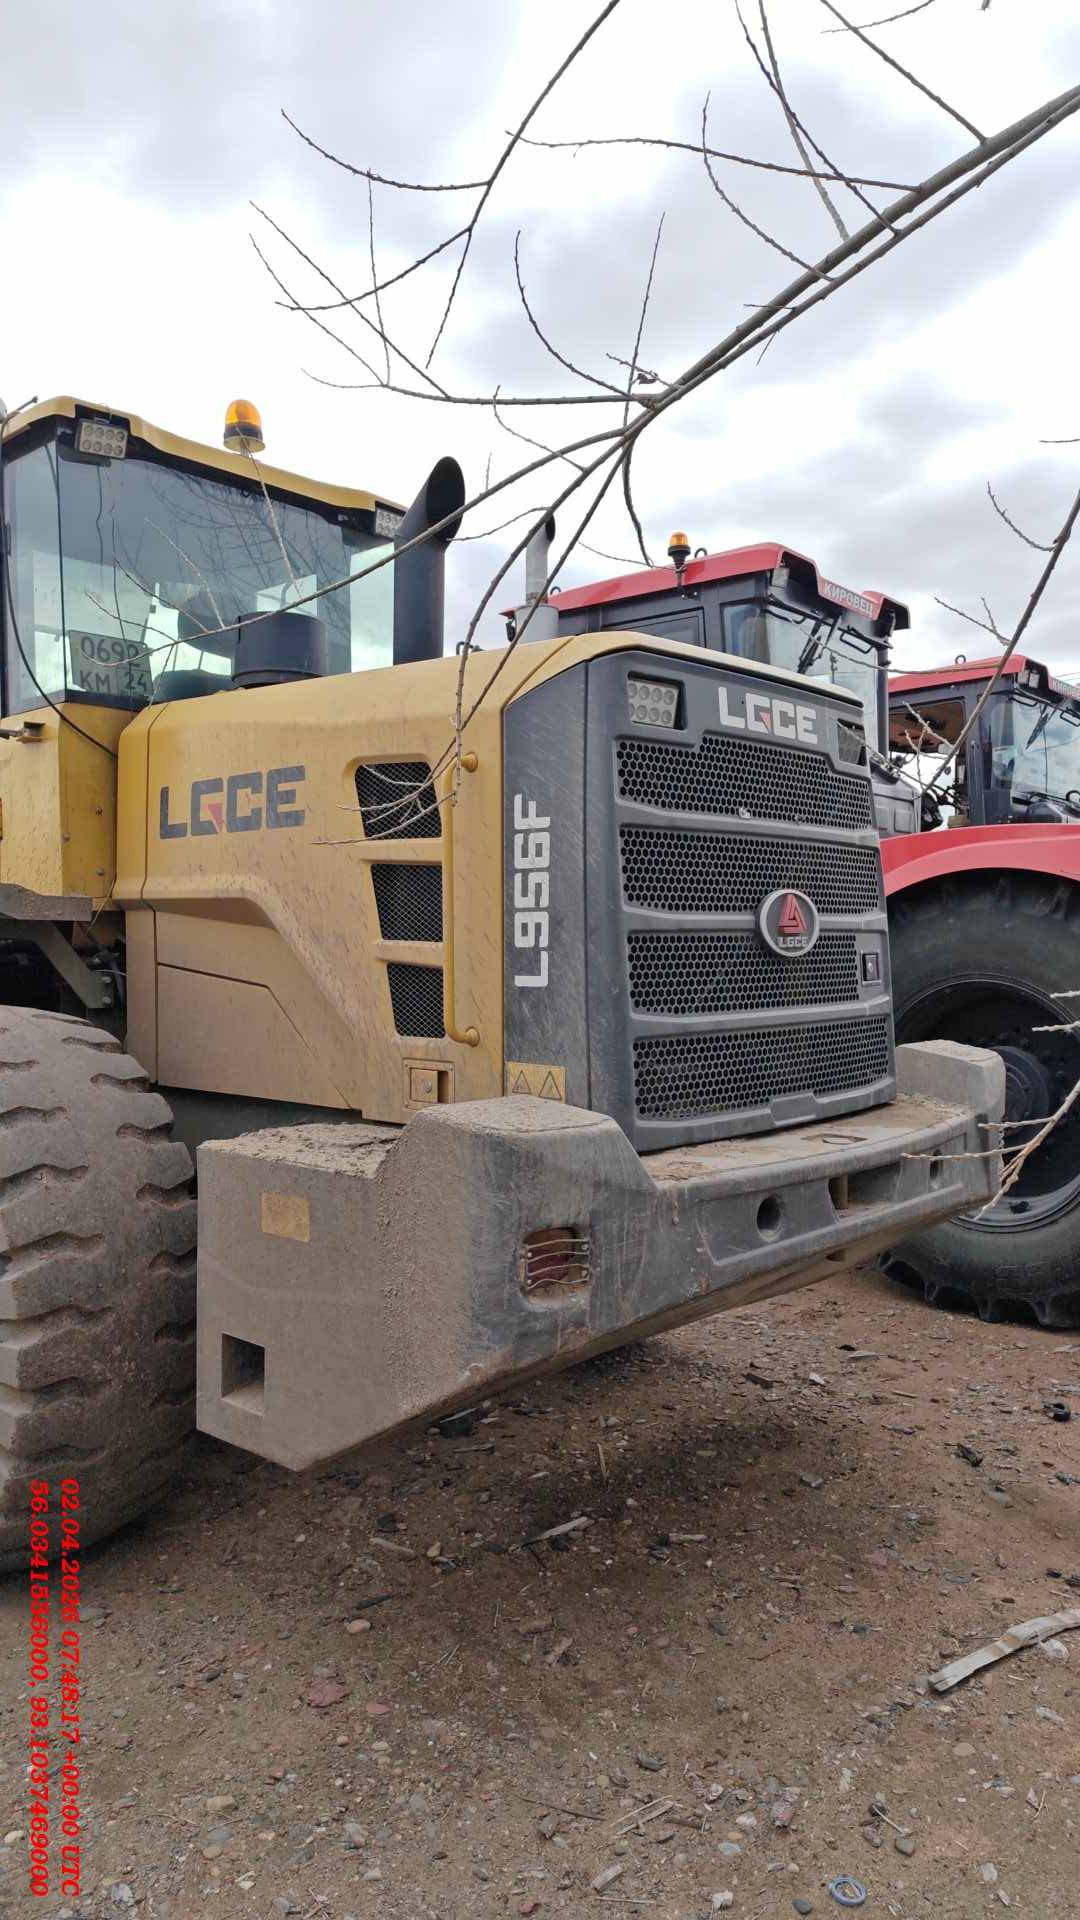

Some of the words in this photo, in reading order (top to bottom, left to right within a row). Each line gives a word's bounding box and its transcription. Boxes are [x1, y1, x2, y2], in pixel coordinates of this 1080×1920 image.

[824, 581, 873, 614] КИРОВЕЦ
[718, 686, 818, 745] LGCE
[513, 793, 551, 988] L956F
